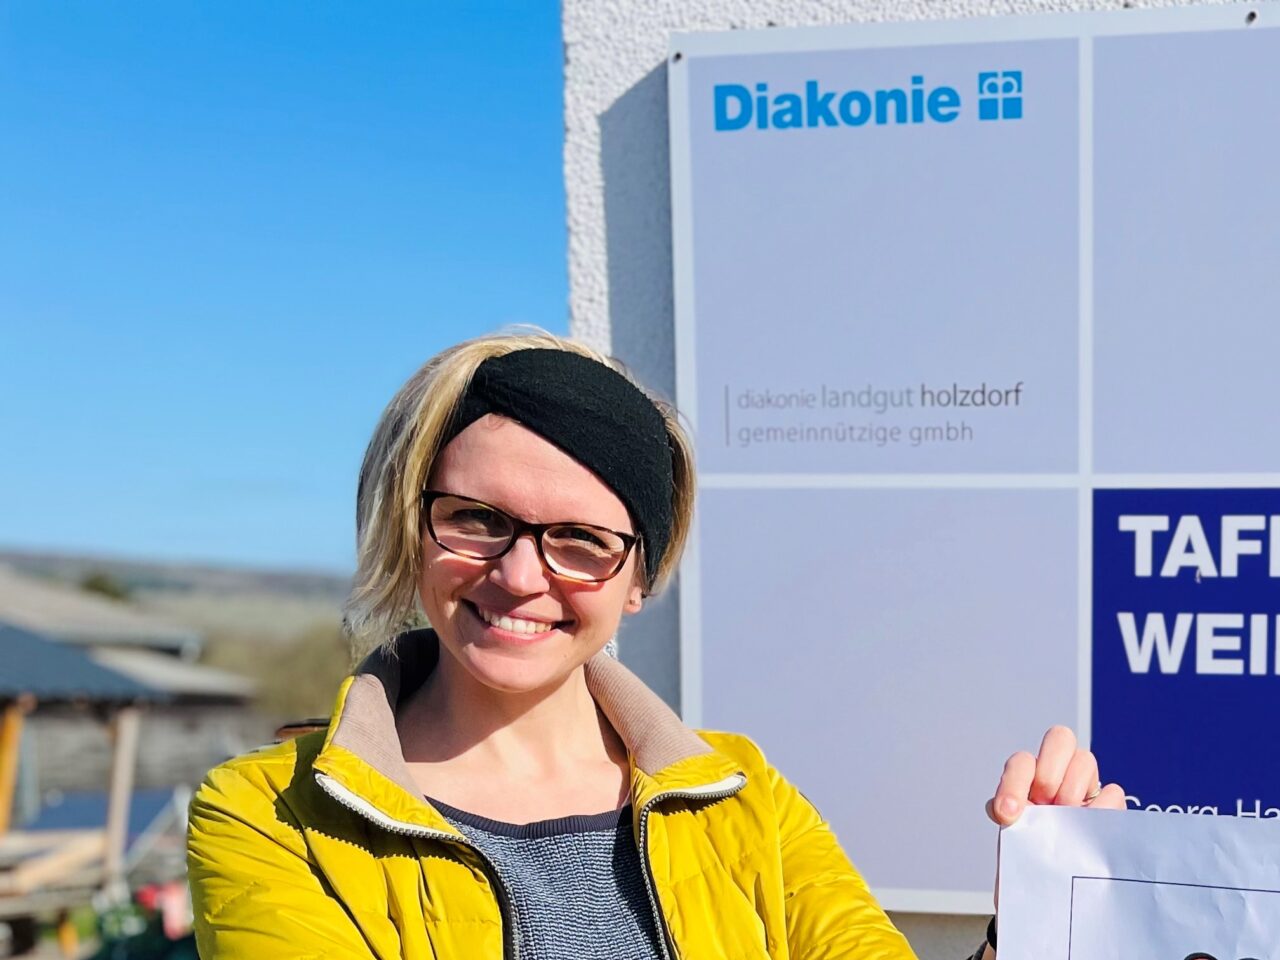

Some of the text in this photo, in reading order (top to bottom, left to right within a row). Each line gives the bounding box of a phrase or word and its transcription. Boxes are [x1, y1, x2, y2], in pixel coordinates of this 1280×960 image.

[713, 75, 961, 132] Diakonie
[736, 381, 1024, 414] diakonie landgut holzdorf
[737, 420, 974, 447] gemeinnützige gmbh
